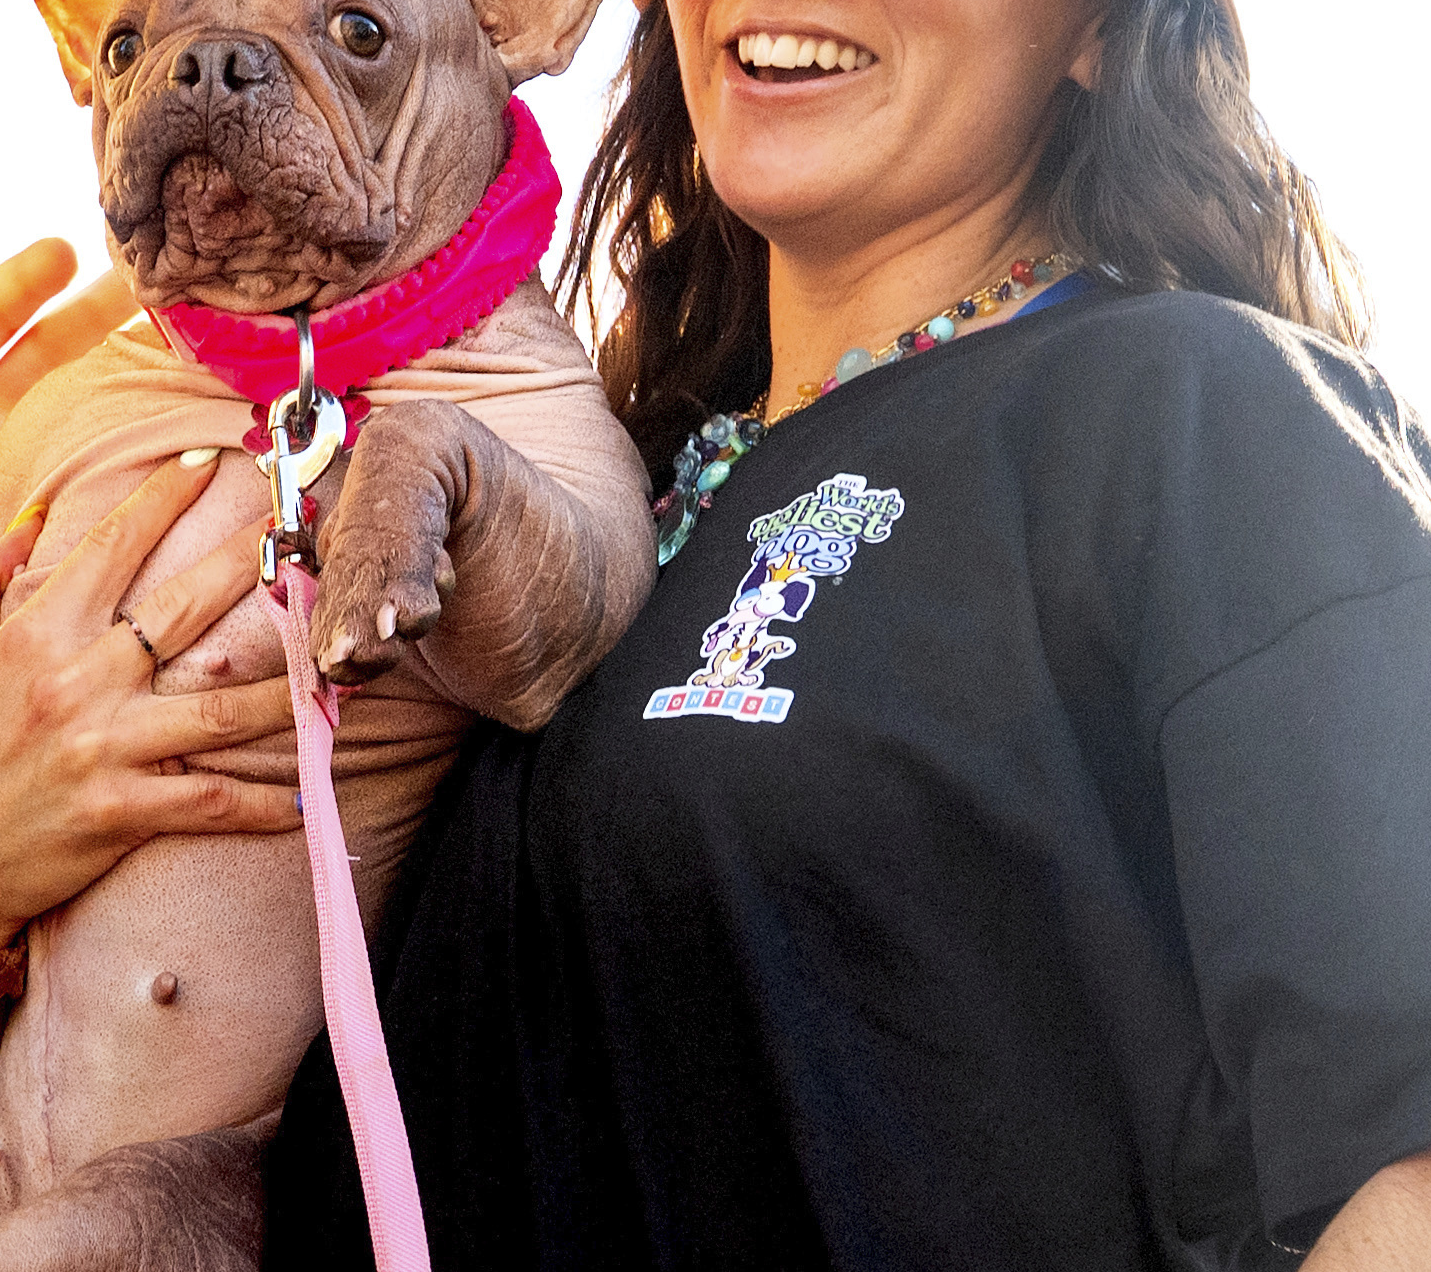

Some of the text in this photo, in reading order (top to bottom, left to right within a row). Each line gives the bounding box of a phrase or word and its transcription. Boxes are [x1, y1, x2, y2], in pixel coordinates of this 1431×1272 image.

[822, 484, 900, 515] World's
[754, 525, 857, 573] dog
[653, 692, 782, 713] CONTEST
